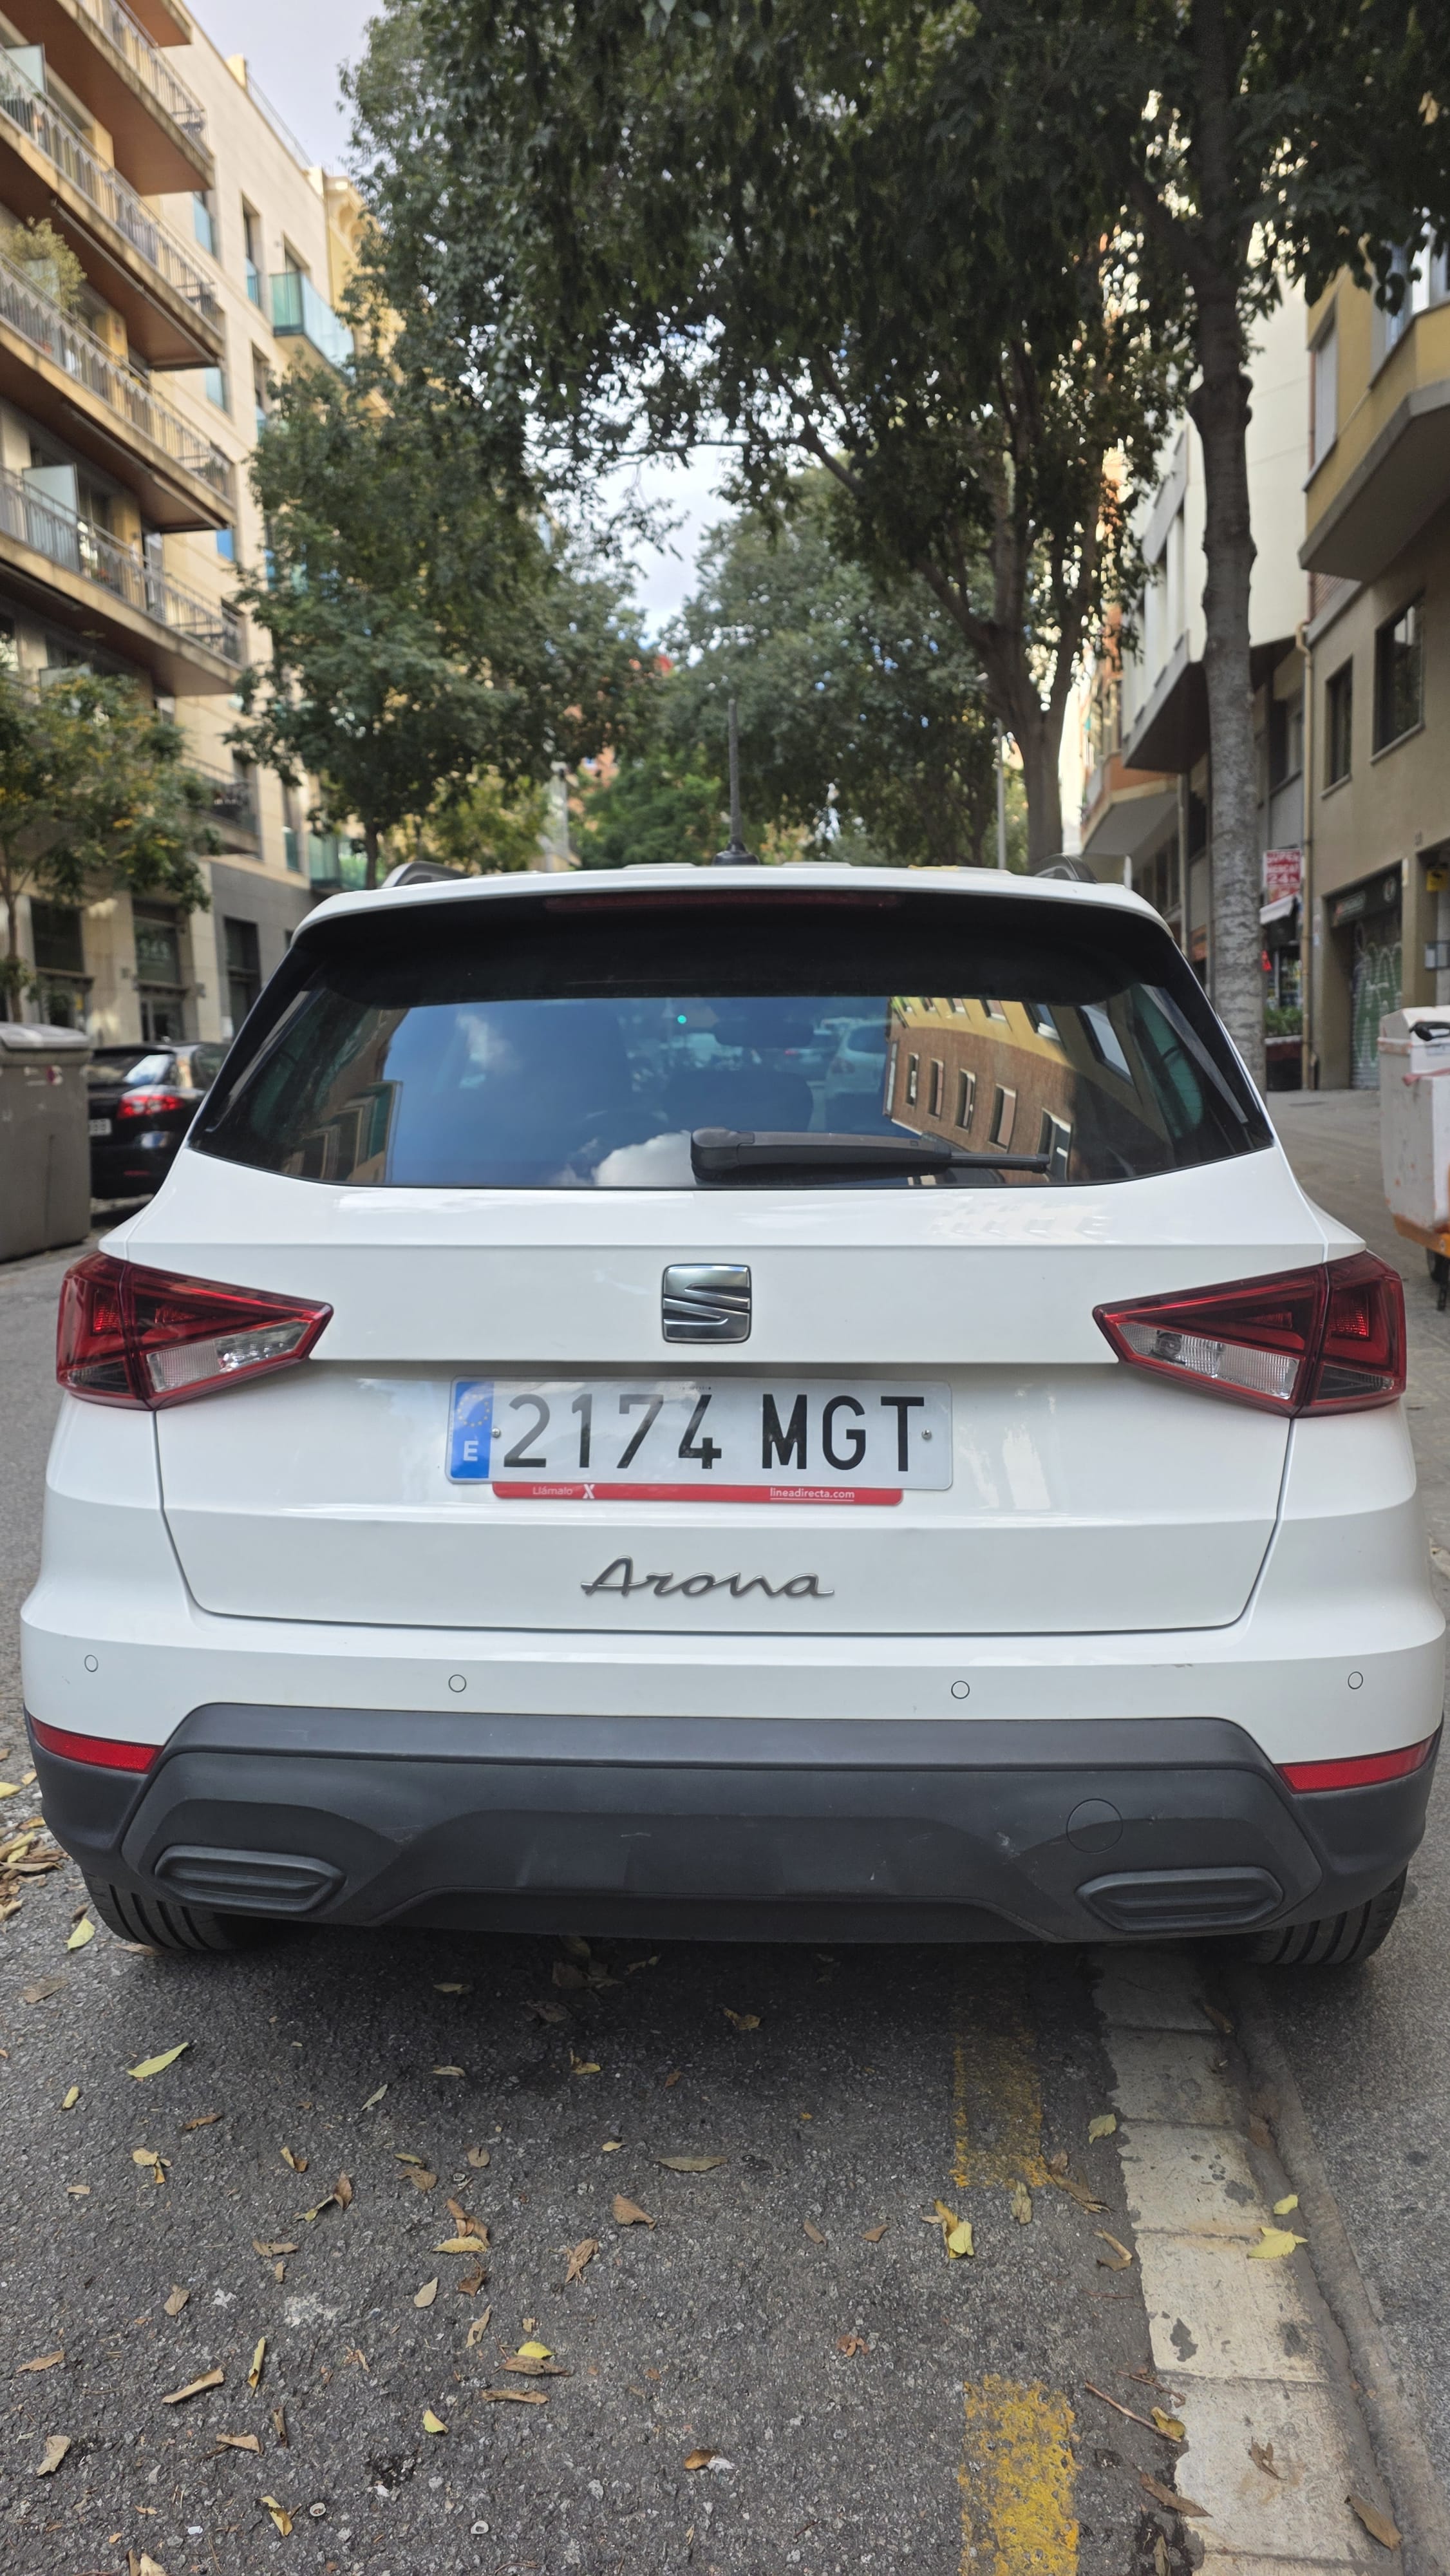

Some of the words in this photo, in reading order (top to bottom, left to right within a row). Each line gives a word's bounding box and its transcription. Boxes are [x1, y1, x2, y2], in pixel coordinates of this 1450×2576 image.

[503, 1393, 722, 1470] 2174
[762, 1393, 925, 1472] MGT
[463, 1441, 479, 1461] E
[532, 1486, 573, 1495] Llámalo
[770, 1487, 855, 1499] lineadirecta.com
[580, 1555, 835, 1597] Arona
